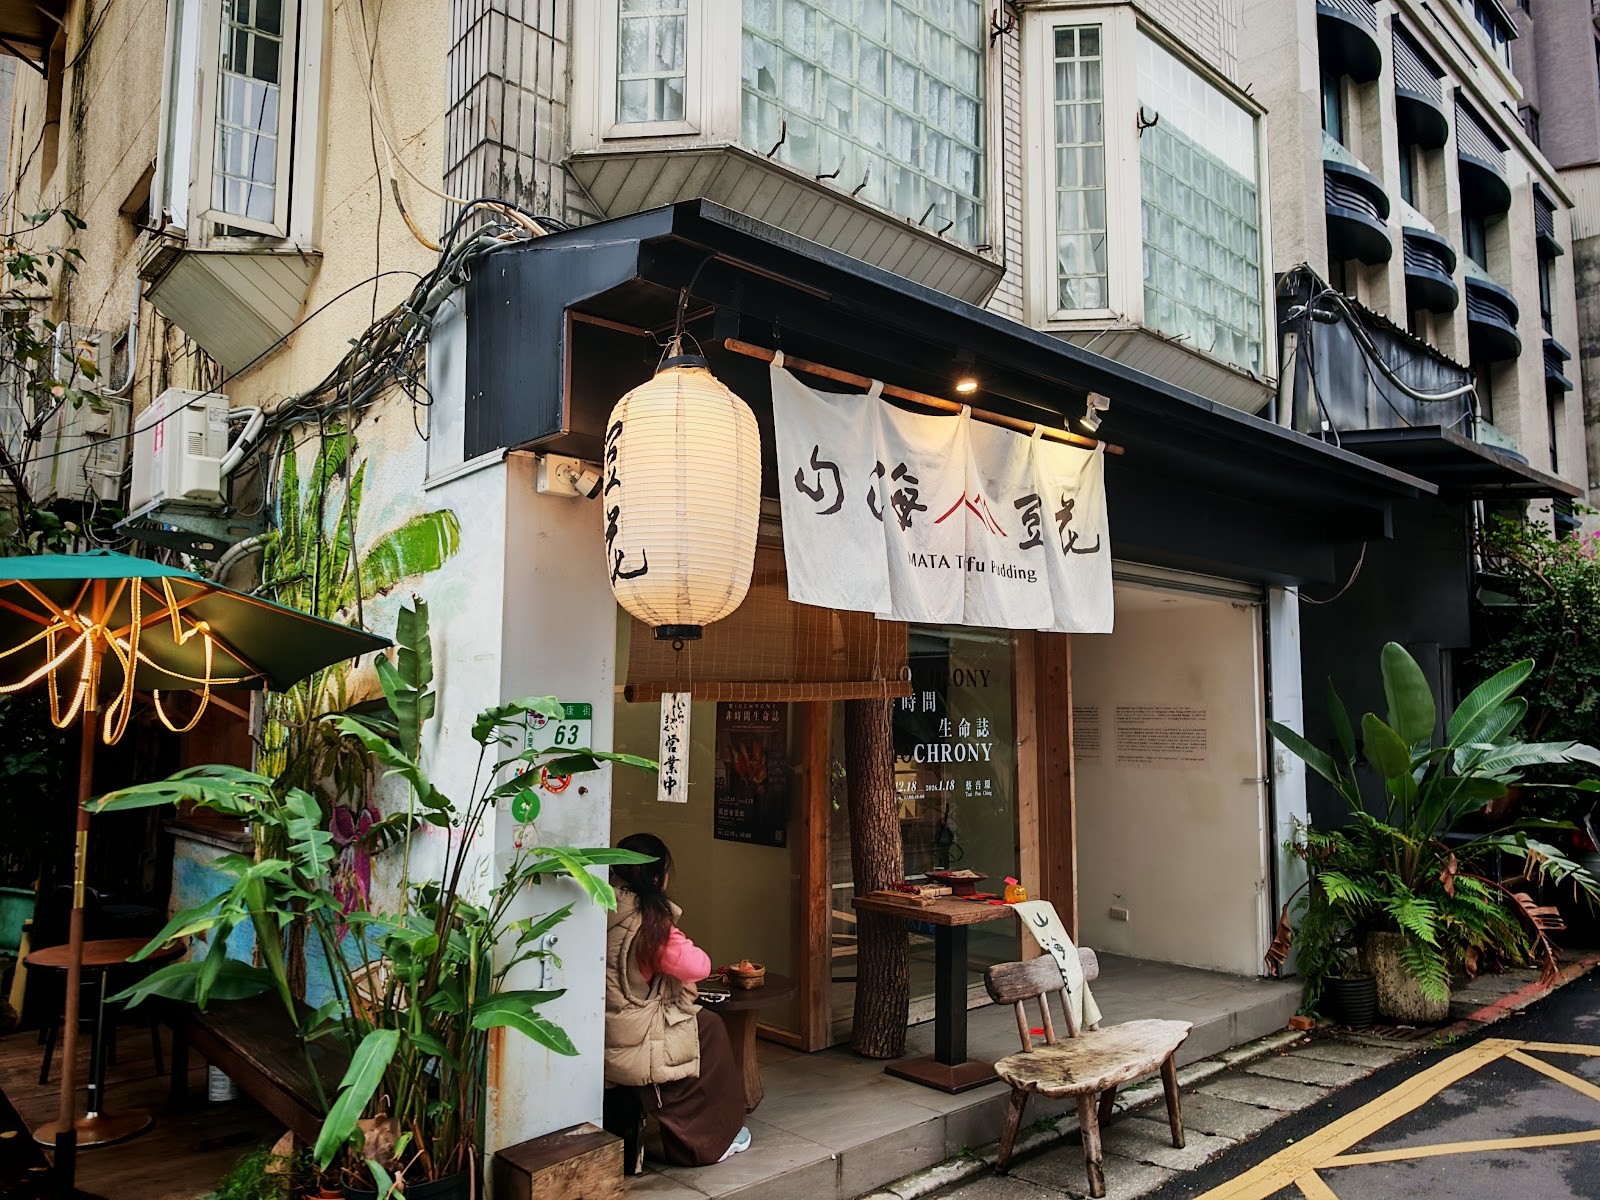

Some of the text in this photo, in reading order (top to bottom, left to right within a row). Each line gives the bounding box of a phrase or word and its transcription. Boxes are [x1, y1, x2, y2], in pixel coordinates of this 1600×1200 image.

[907, 551, 951, 569] MATA
[893, 691, 936, 713] 時間
[554, 724, 579, 745] 63
[939, 717, 990, 738] 生命誌
